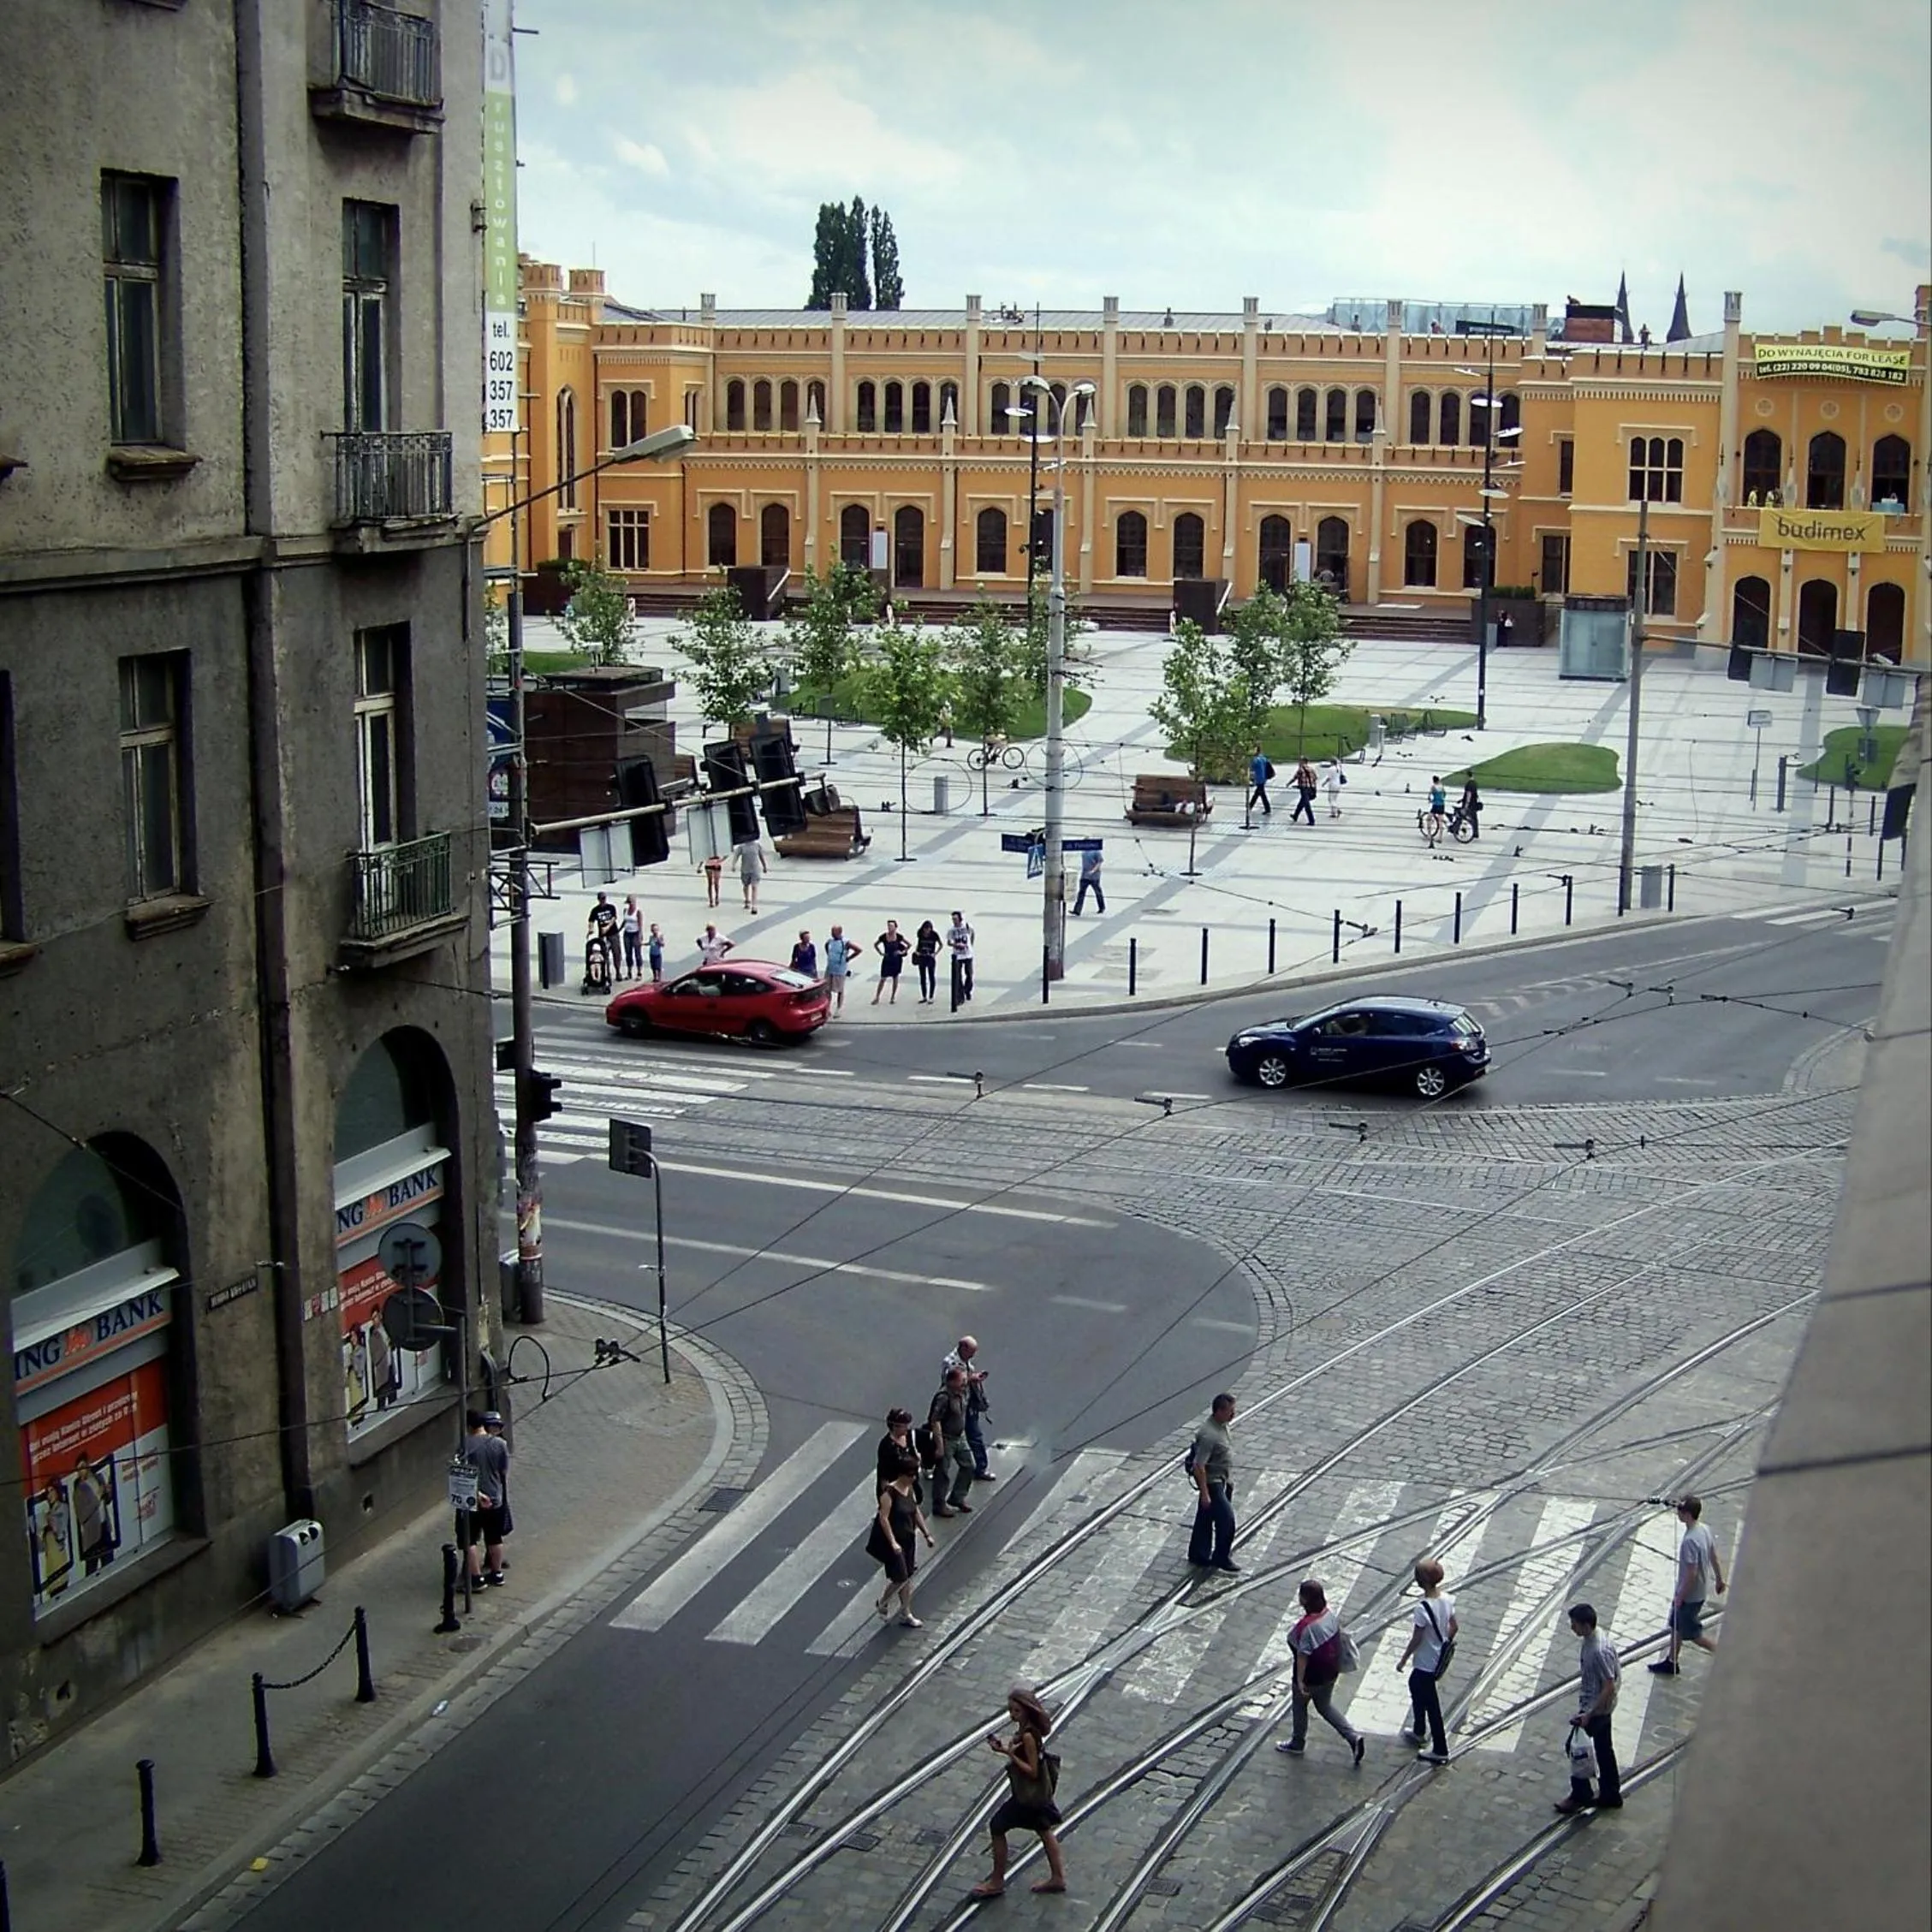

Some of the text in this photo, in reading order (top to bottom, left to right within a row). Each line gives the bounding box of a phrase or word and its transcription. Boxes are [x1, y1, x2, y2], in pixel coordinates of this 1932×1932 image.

[492, 321, 510, 338] tel.
[490, 351, 514, 372] 602
[1757, 348, 1906, 366] DO WYNAJĘCIA FOR LEASE
[490, 381, 514, 401] 357
[490, 409, 514, 429] 357
[1777, 516, 1866, 542] budimex
[335, 1165, 440, 1234] NG BANK
[15, 1338, 61, 1382] ING
[96, 1290, 164, 1342] BANK
